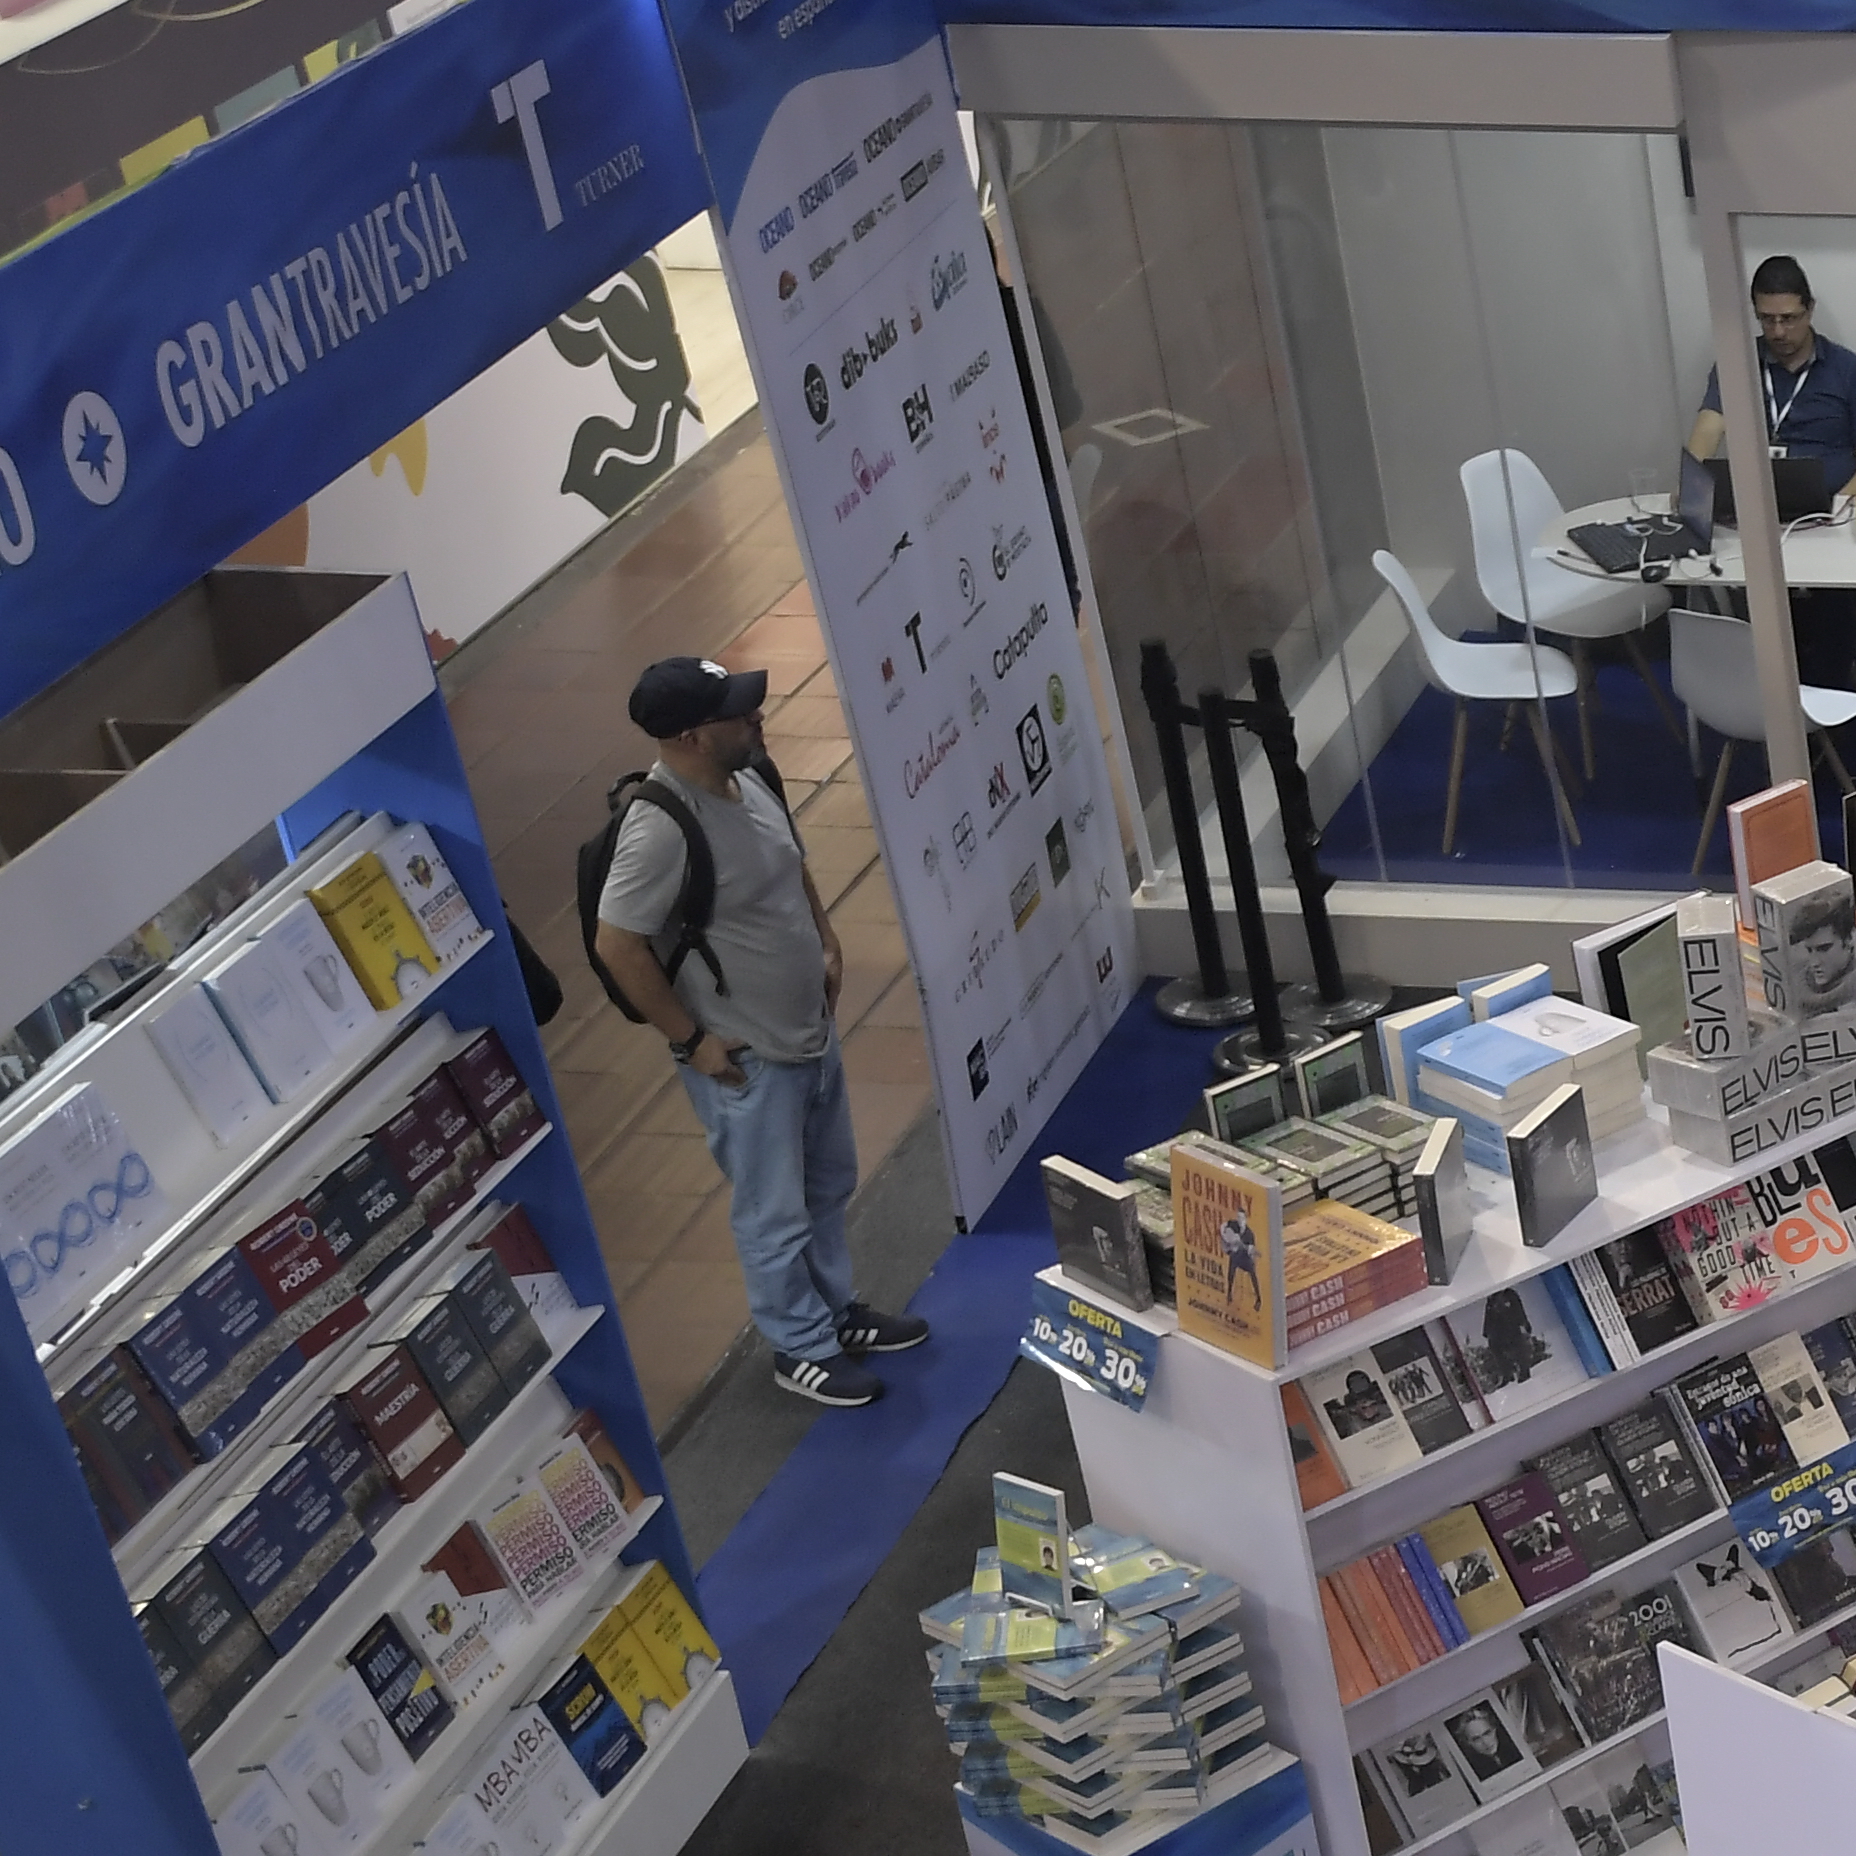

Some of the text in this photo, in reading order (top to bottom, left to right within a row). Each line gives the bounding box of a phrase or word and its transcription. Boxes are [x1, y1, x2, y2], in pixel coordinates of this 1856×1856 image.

[490, 60, 563, 232] T
[862, 117, 897, 164] OCEANO
[574, 143, 646, 209] TURNER
[798, 172, 835, 219] OCEANO
[759, 206, 796, 253] OCEANO
[1757, 898, 1787, 1011] ELVIS
[1684, 939, 1730, 1058] ELVIS
[1721, 1045, 1801, 1115] ELVIS
[1731, 1094, 1824, 1164] ELVIS
[1182, 1169, 1253, 1216] JOHNNY
[279, 1252, 324, 1295] PODER
[1698, 1245, 1736, 1278] GOOD
[1740, 1255, 1775, 1284] TIME
[1310, 1275, 1344, 1301] CASH
[1312, 1292, 1345, 1317] CASH
[1067, 1299, 1125, 1341] OFERTA
[1316, 1310, 1350, 1335] CASH
[1771, 1462, 1833, 1502] OFERTA
[520, 1548, 574, 1590] PERMISO
[473, 1764, 521, 1813] MBA
